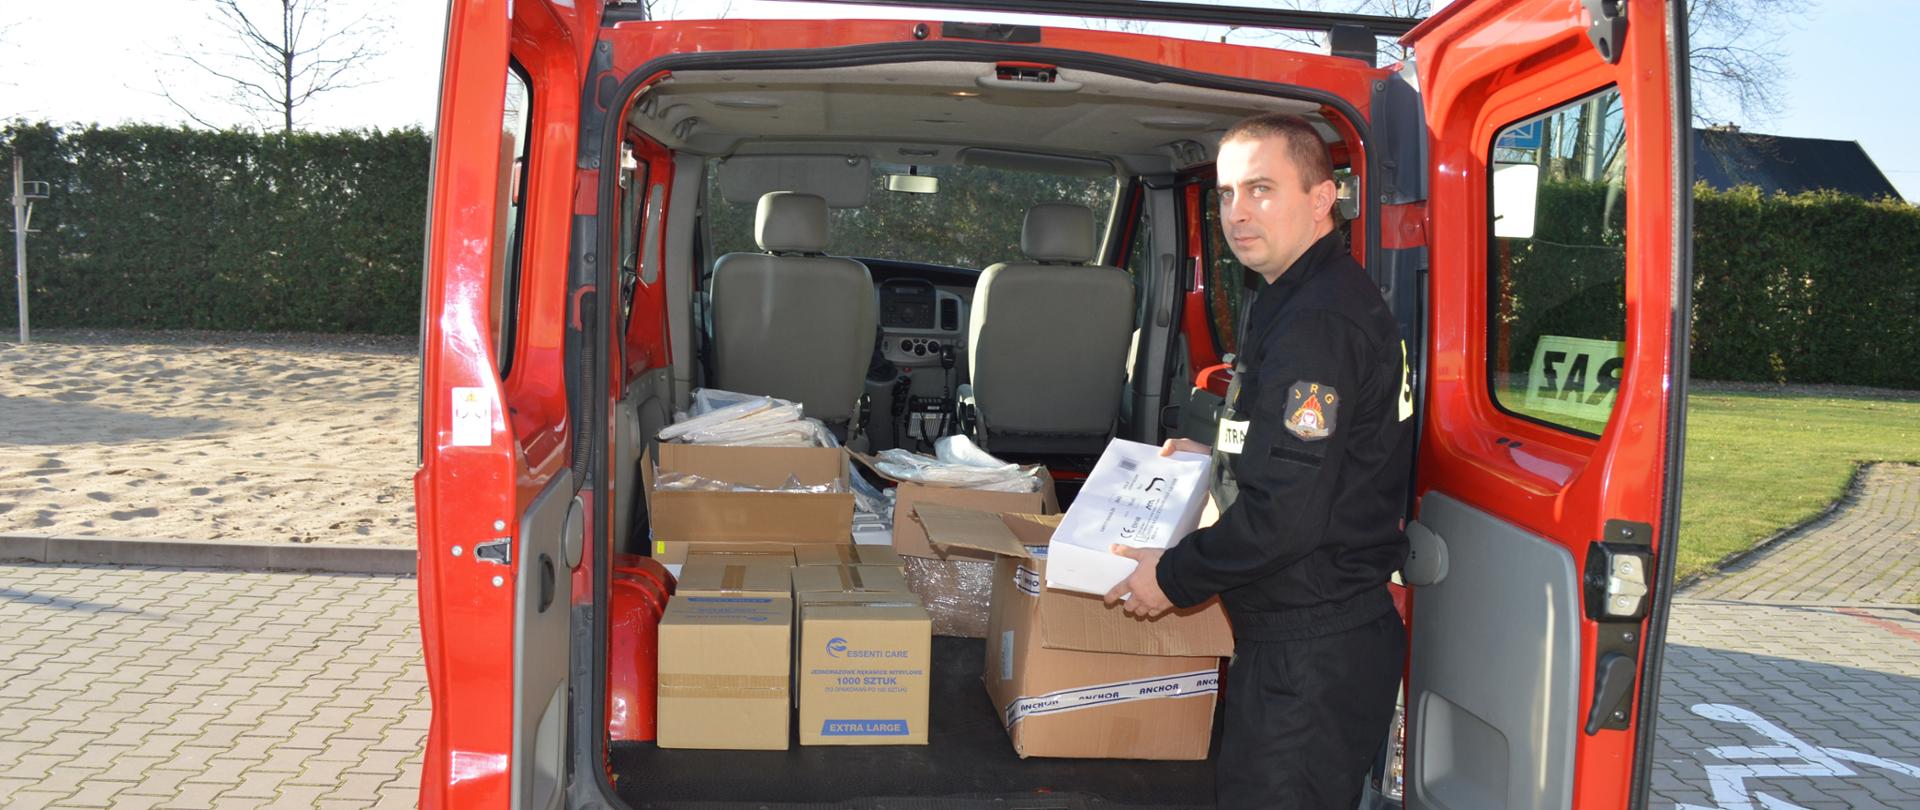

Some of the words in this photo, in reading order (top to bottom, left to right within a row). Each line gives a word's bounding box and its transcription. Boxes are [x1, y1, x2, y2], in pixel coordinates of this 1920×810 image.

[847, 650, 882, 658] ESSENTI
[885, 650, 908, 658] CARE
[837, 677, 860, 685] 1000
[863, 677, 897, 685] SZTUK
[1139, 683, 1179, 694] ANCHOR
[830, 723, 864, 732] EXTRA
[866, 723, 901, 732] LARGE
